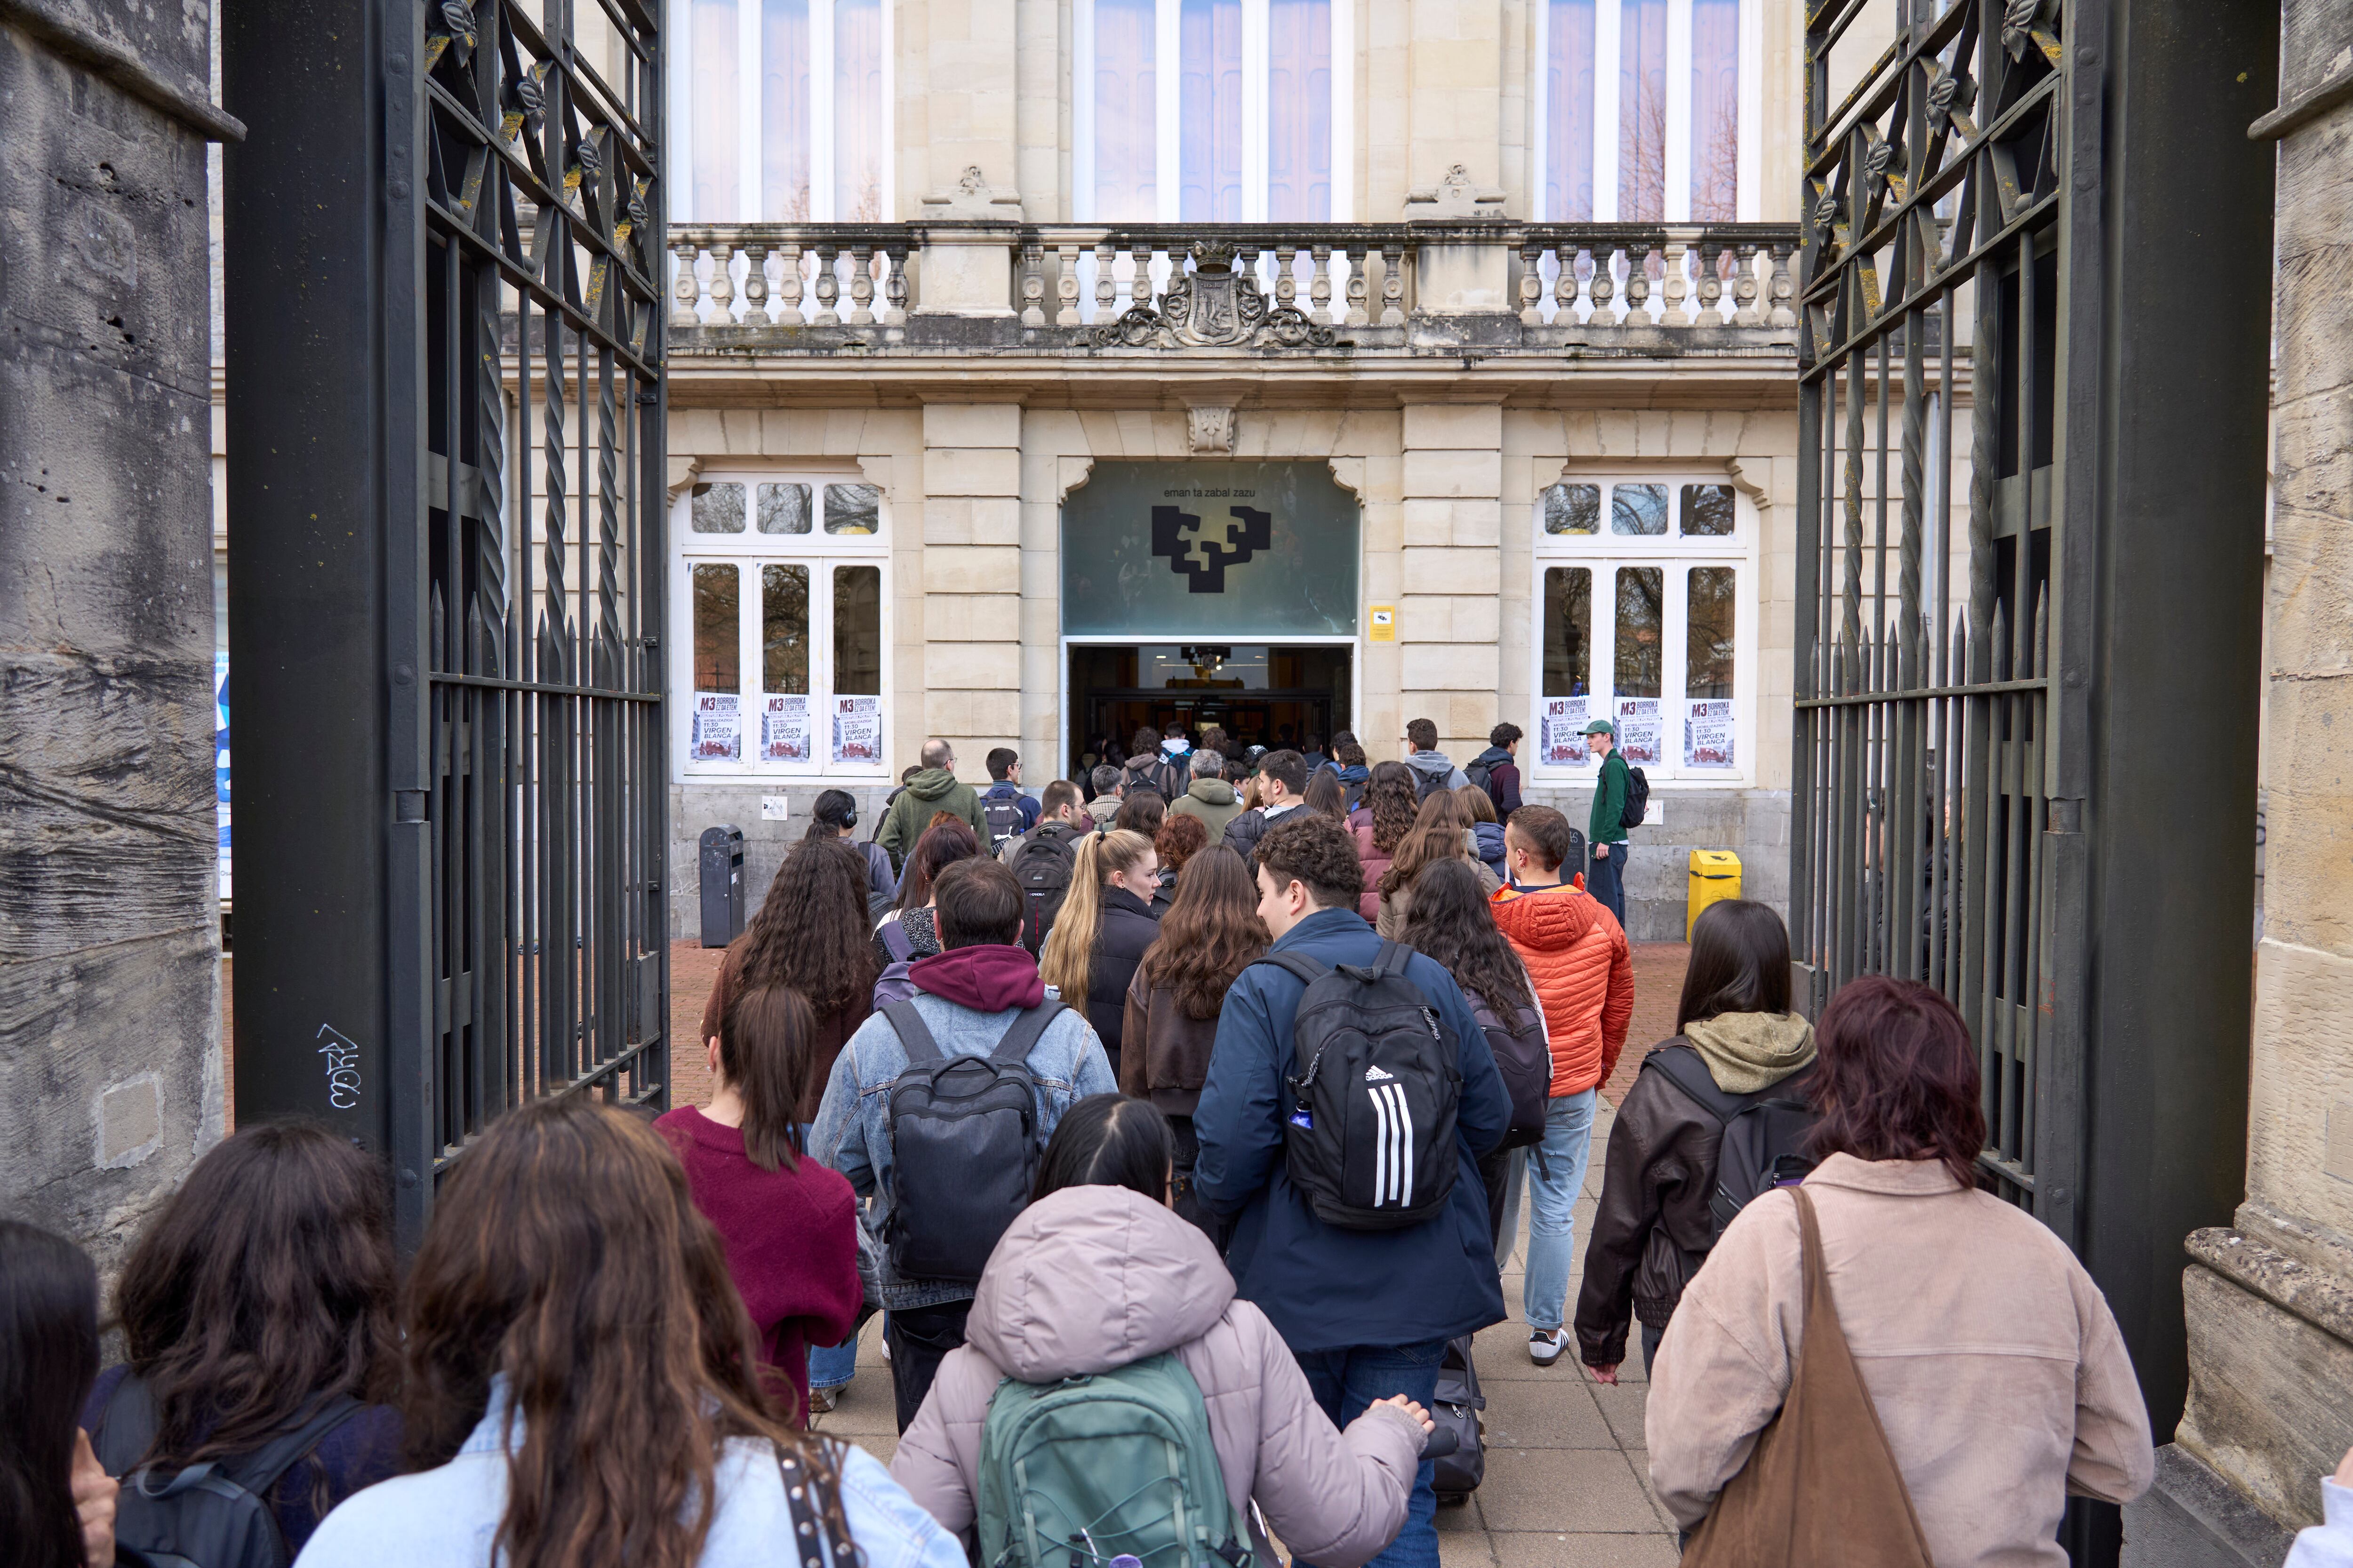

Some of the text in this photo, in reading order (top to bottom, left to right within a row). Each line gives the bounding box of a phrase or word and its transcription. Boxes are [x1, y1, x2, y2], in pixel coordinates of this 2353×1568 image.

[1193, 488, 1202, 497] ta
[1205, 488, 1230, 497] zabal
[700, 697, 716, 711] M3
[768, 698, 784, 712] M3
[784, 697, 805, 705] BORROKA
[839, 699, 854, 713] M3
[855, 697, 875, 706] BORROKA
[1565, 699, 1585, 708] BORROKA
[1637, 700, 1657, 708] BORROKA
[1708, 701, 1729, 710] BORROKA
[1548, 701, 1564, 715] M3
[1620, 701, 1636, 715] M3
[1691, 703, 1707, 717] M3
